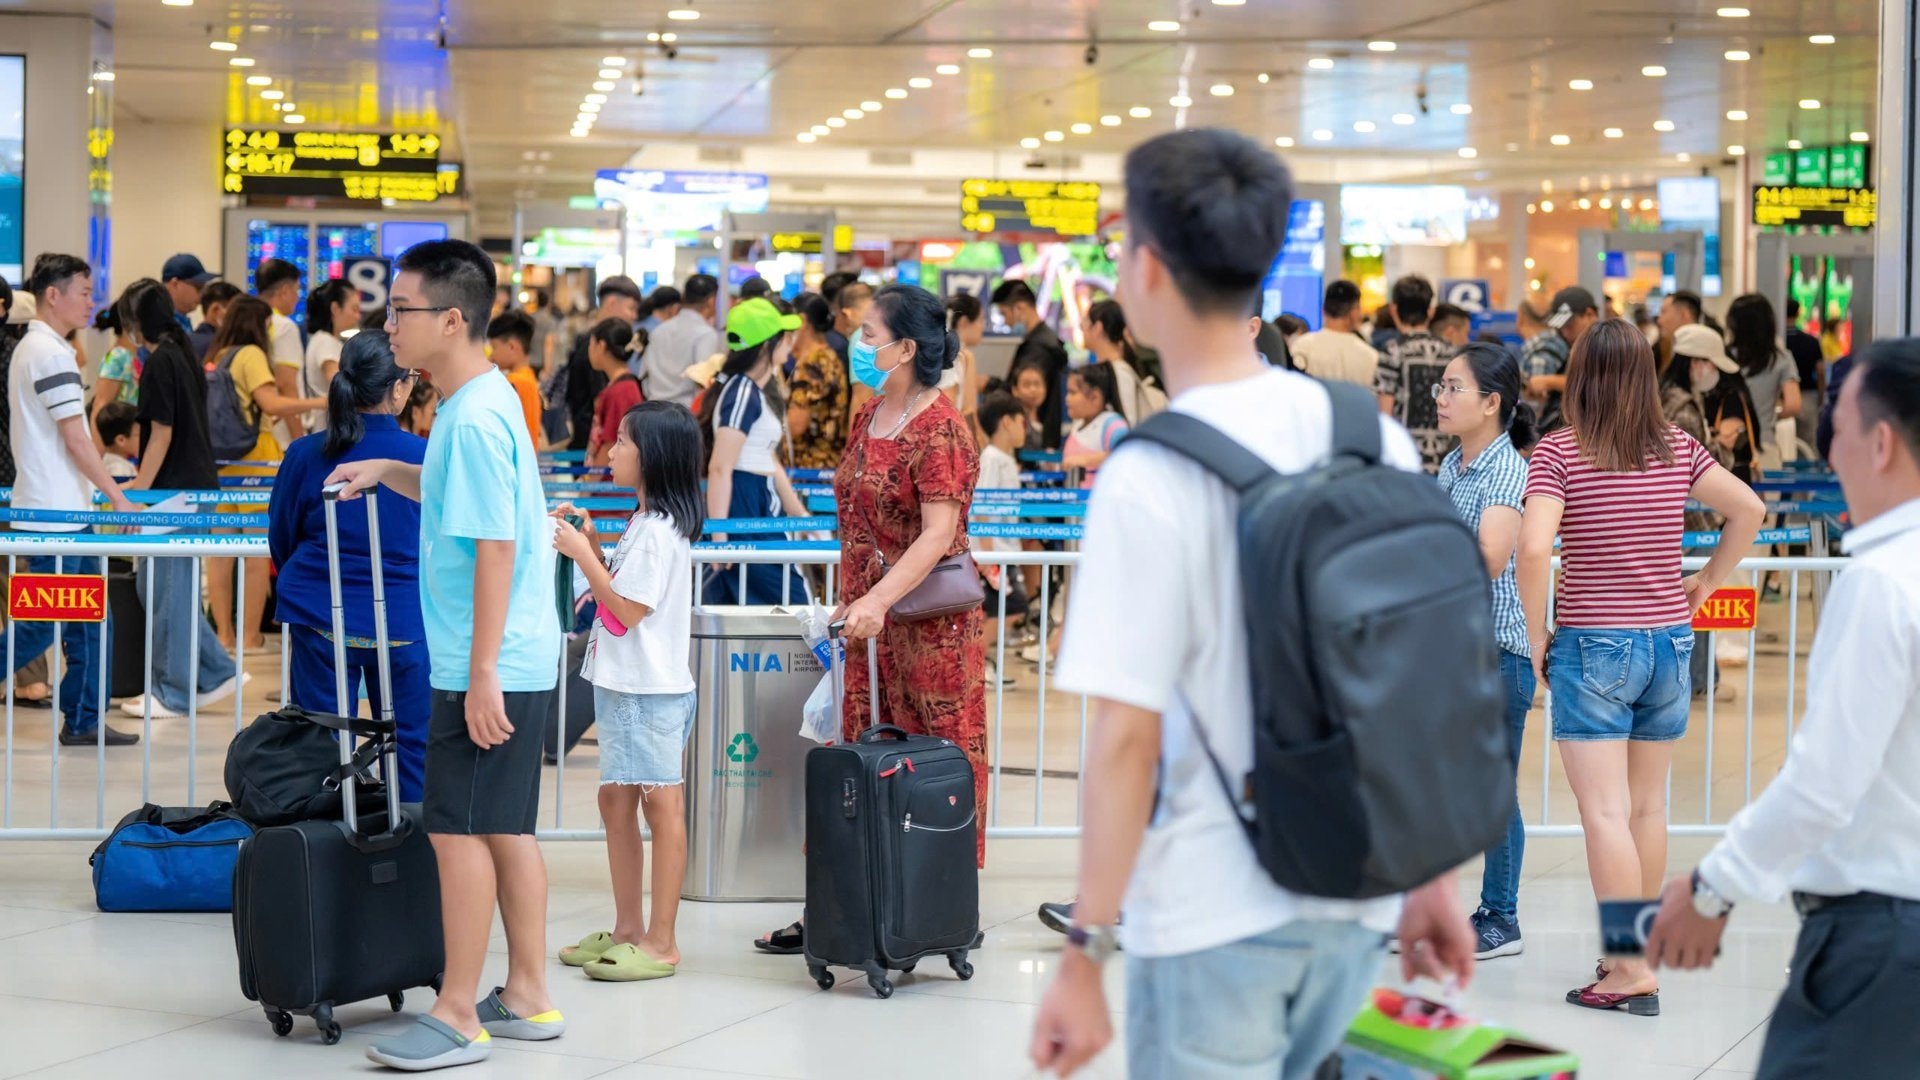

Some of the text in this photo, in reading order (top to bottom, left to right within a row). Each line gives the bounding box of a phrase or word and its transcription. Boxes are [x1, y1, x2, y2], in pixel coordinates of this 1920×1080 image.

[348, 260, 388, 312] 8
[1789, 528, 1810, 540] SEC
[14, 587, 100, 608] ANHK
[1694, 598, 1751, 619] NHK
[730, 652, 782, 672] NIA
